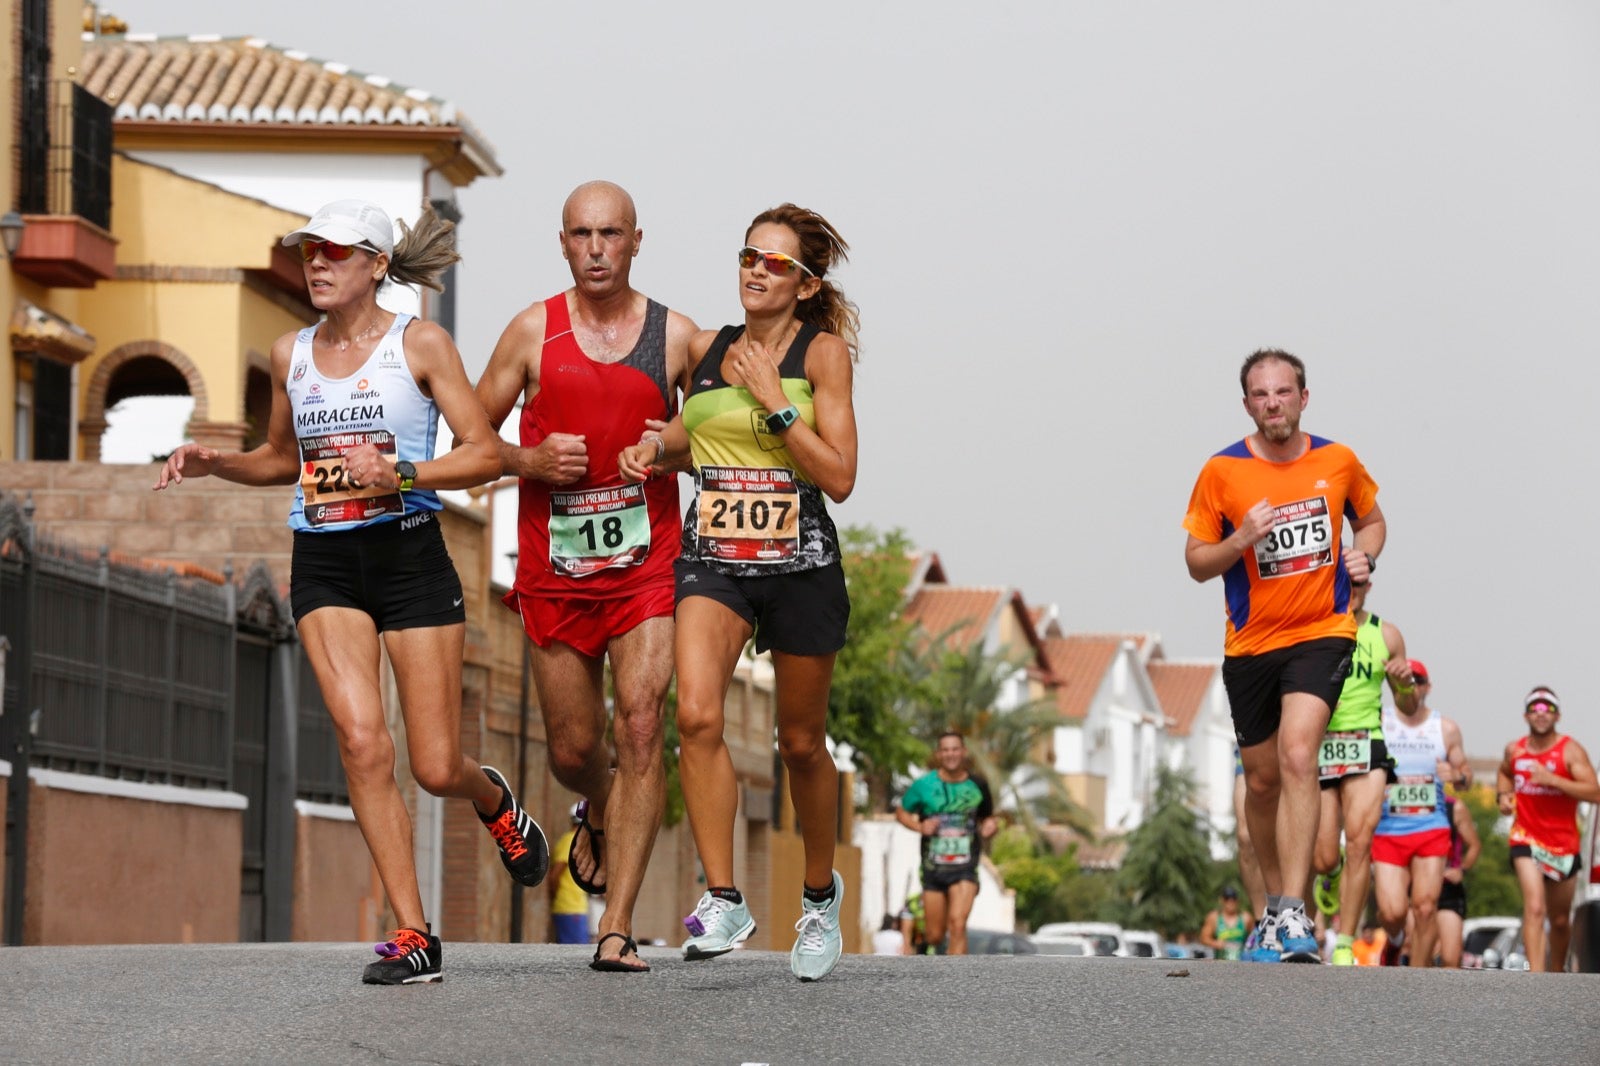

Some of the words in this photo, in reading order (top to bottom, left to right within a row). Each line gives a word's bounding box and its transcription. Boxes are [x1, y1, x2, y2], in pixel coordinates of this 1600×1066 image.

[297, 404, 384, 428] MARACENA
[306, 427, 321, 435] CLUB
[333, 422, 373, 431] ATLETISMO
[330, 434, 354, 447] PREMIO
[355, 433, 364, 445] DE
[718, 469, 734, 481] GRAN
[735, 470, 760, 482] PREMIO
[760, 470, 769, 482] DE
[567, 494, 585, 506] GRAN
[585, 491, 611, 504] PREMIO
[611, 489, 620, 500] DE
[621, 486, 639, 499] FONDO
[401, 511, 431, 531] NIKE
[710, 498, 792, 531] 2107
[578, 516, 624, 551] 18
[1264, 520, 1327, 553] 3075
[1324, 742, 1360, 761] 883
[1398, 787, 1430, 802] 656
